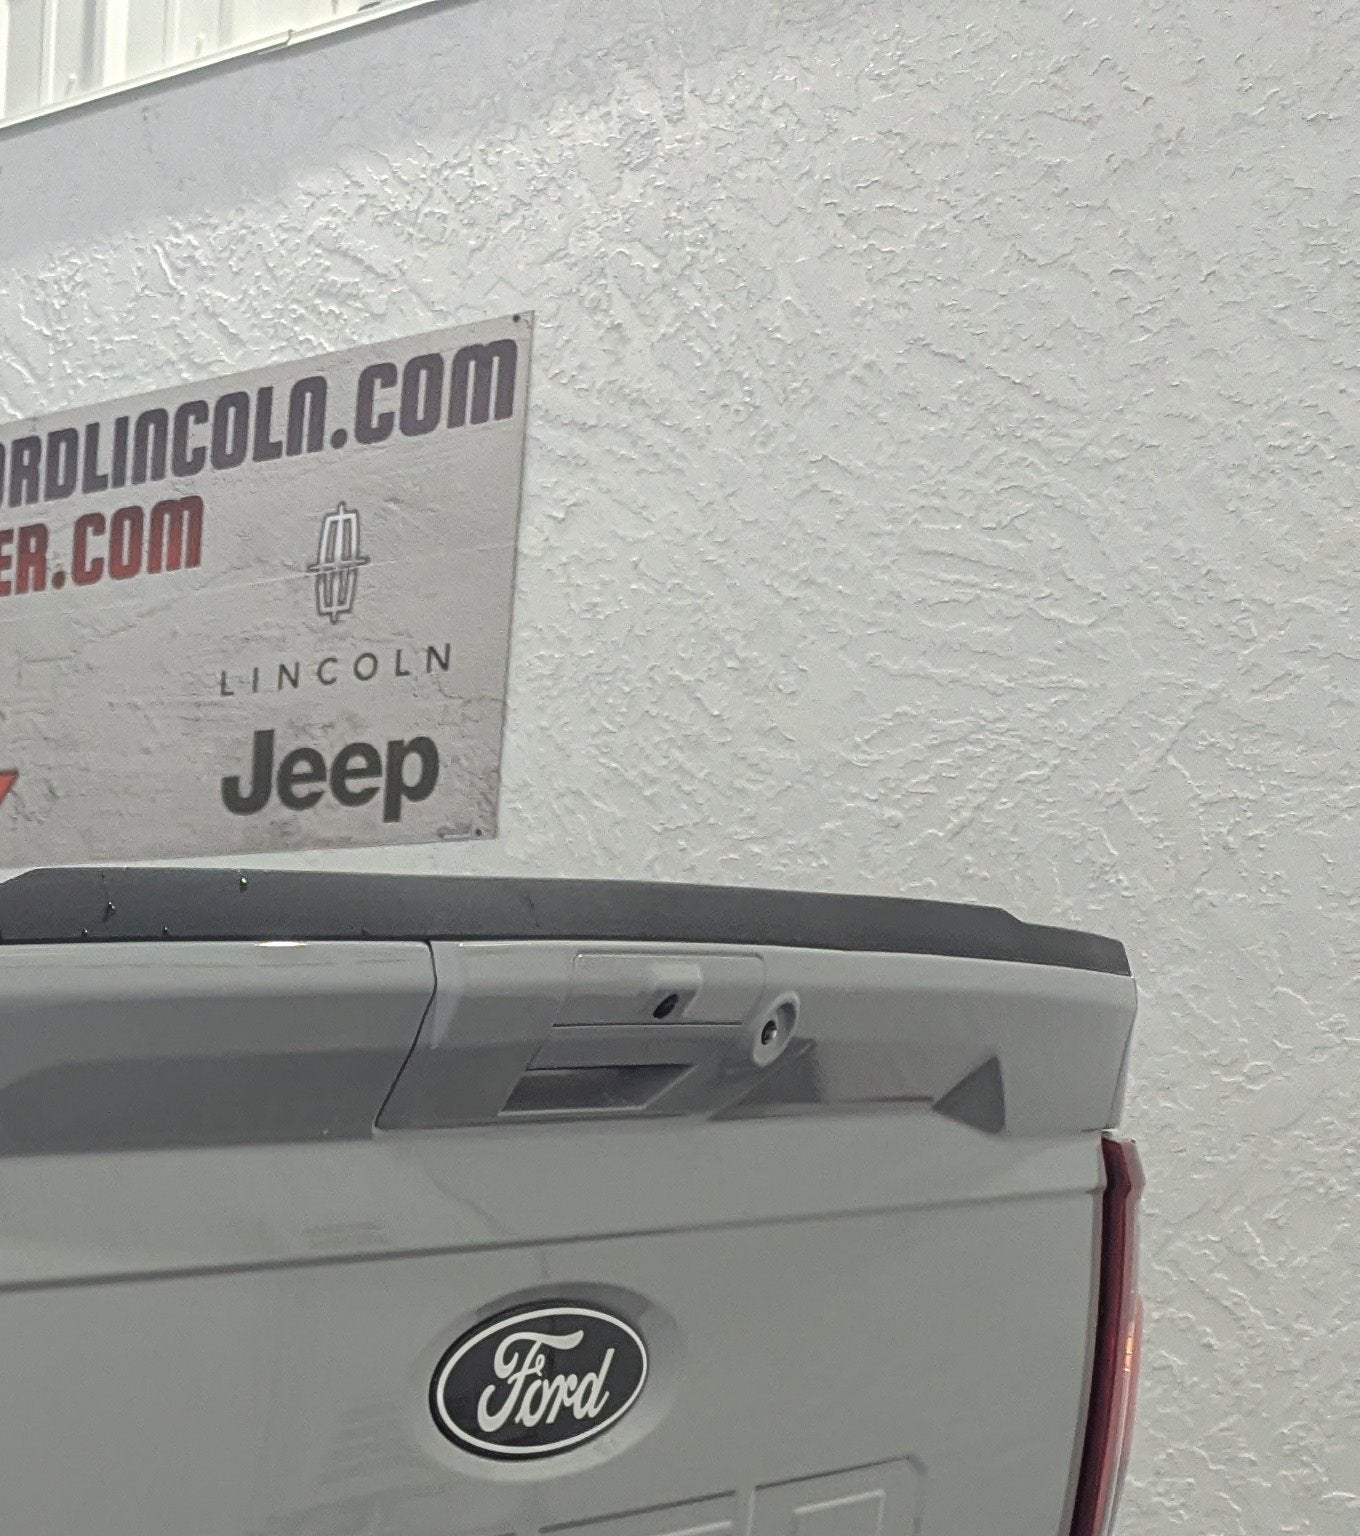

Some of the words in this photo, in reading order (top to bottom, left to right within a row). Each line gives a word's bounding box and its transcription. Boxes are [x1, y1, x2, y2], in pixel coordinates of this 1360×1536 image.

[219, 642, 452, 697] LINCOLN
[220, 729, 441, 824] Jeep
[476, 1328, 616, 1433] Ford
